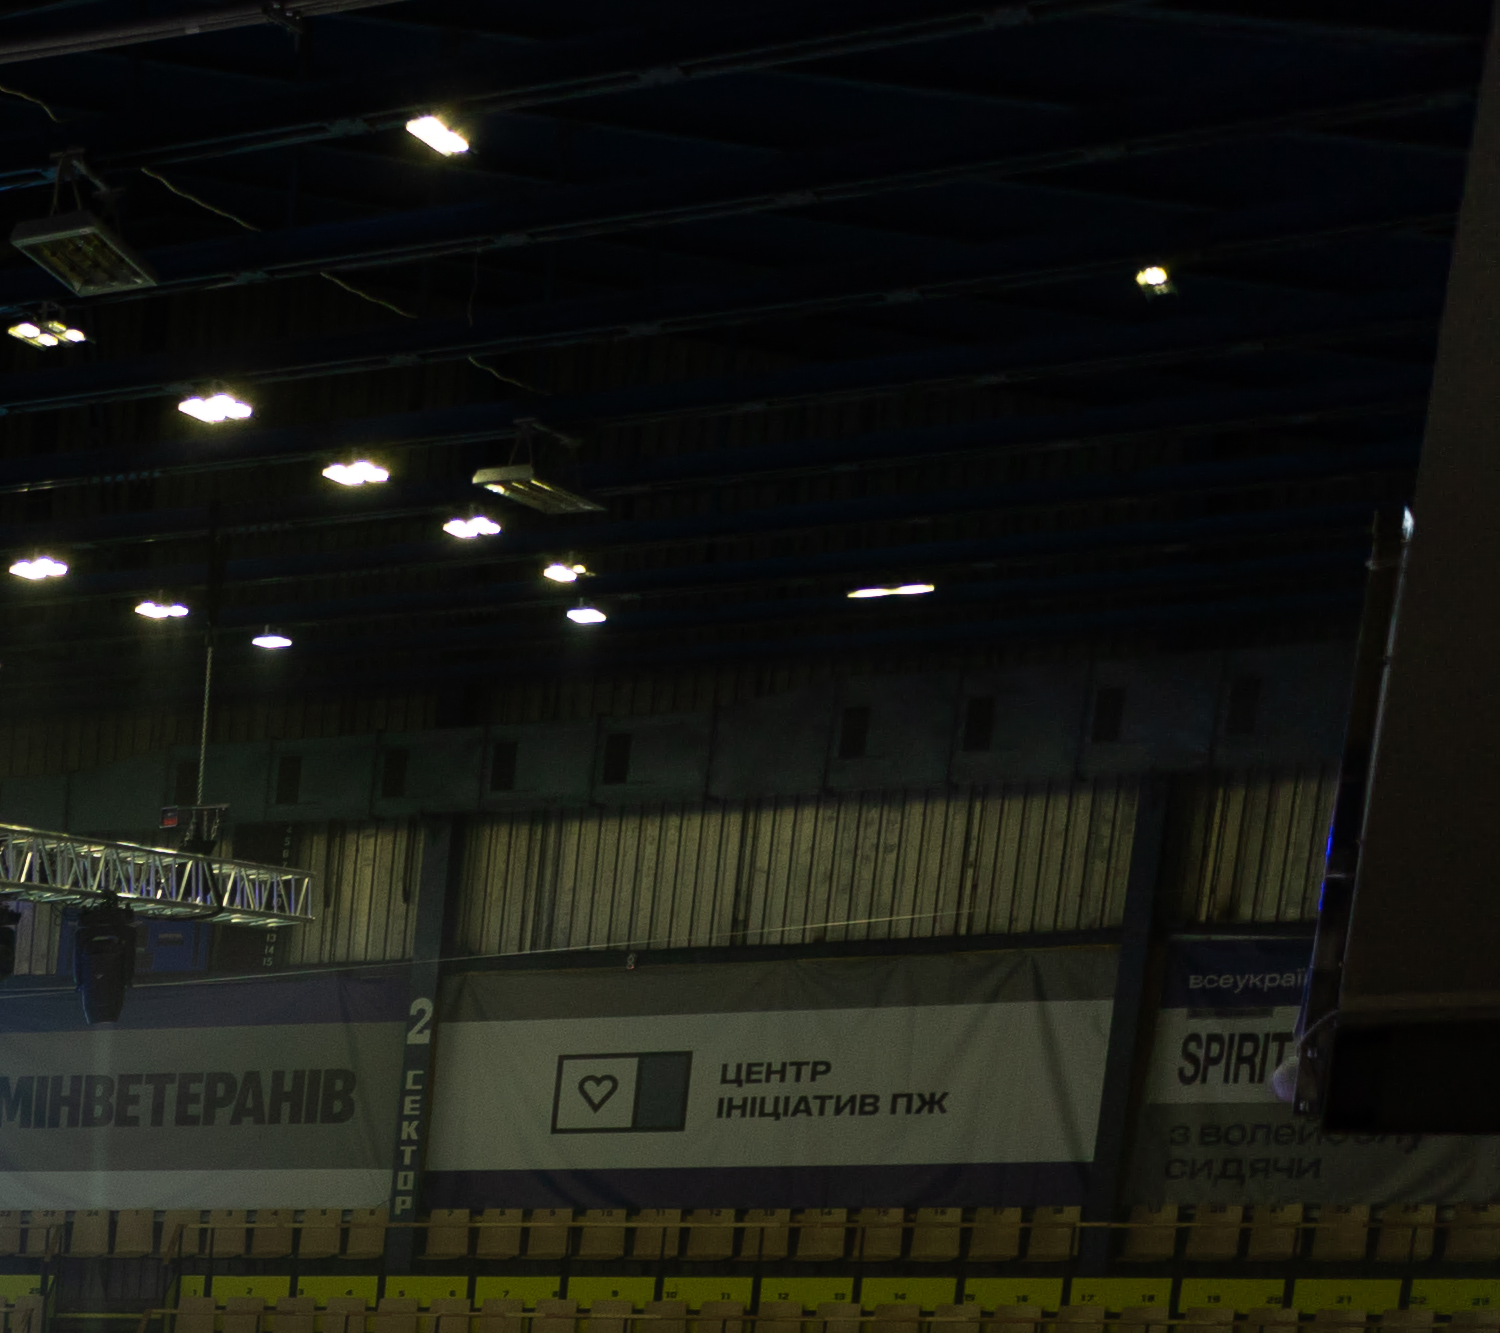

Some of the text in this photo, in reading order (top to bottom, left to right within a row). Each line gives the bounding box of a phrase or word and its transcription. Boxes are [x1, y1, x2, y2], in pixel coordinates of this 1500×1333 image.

[406, 997, 434, 1044] 2
[721, 1060, 832, 1087] ЦЕНТР
[716, 1090, 950, 1122] ІНІЦІАТИВ ПЖ
[394, 1069, 424, 1217] СЕКТОР
